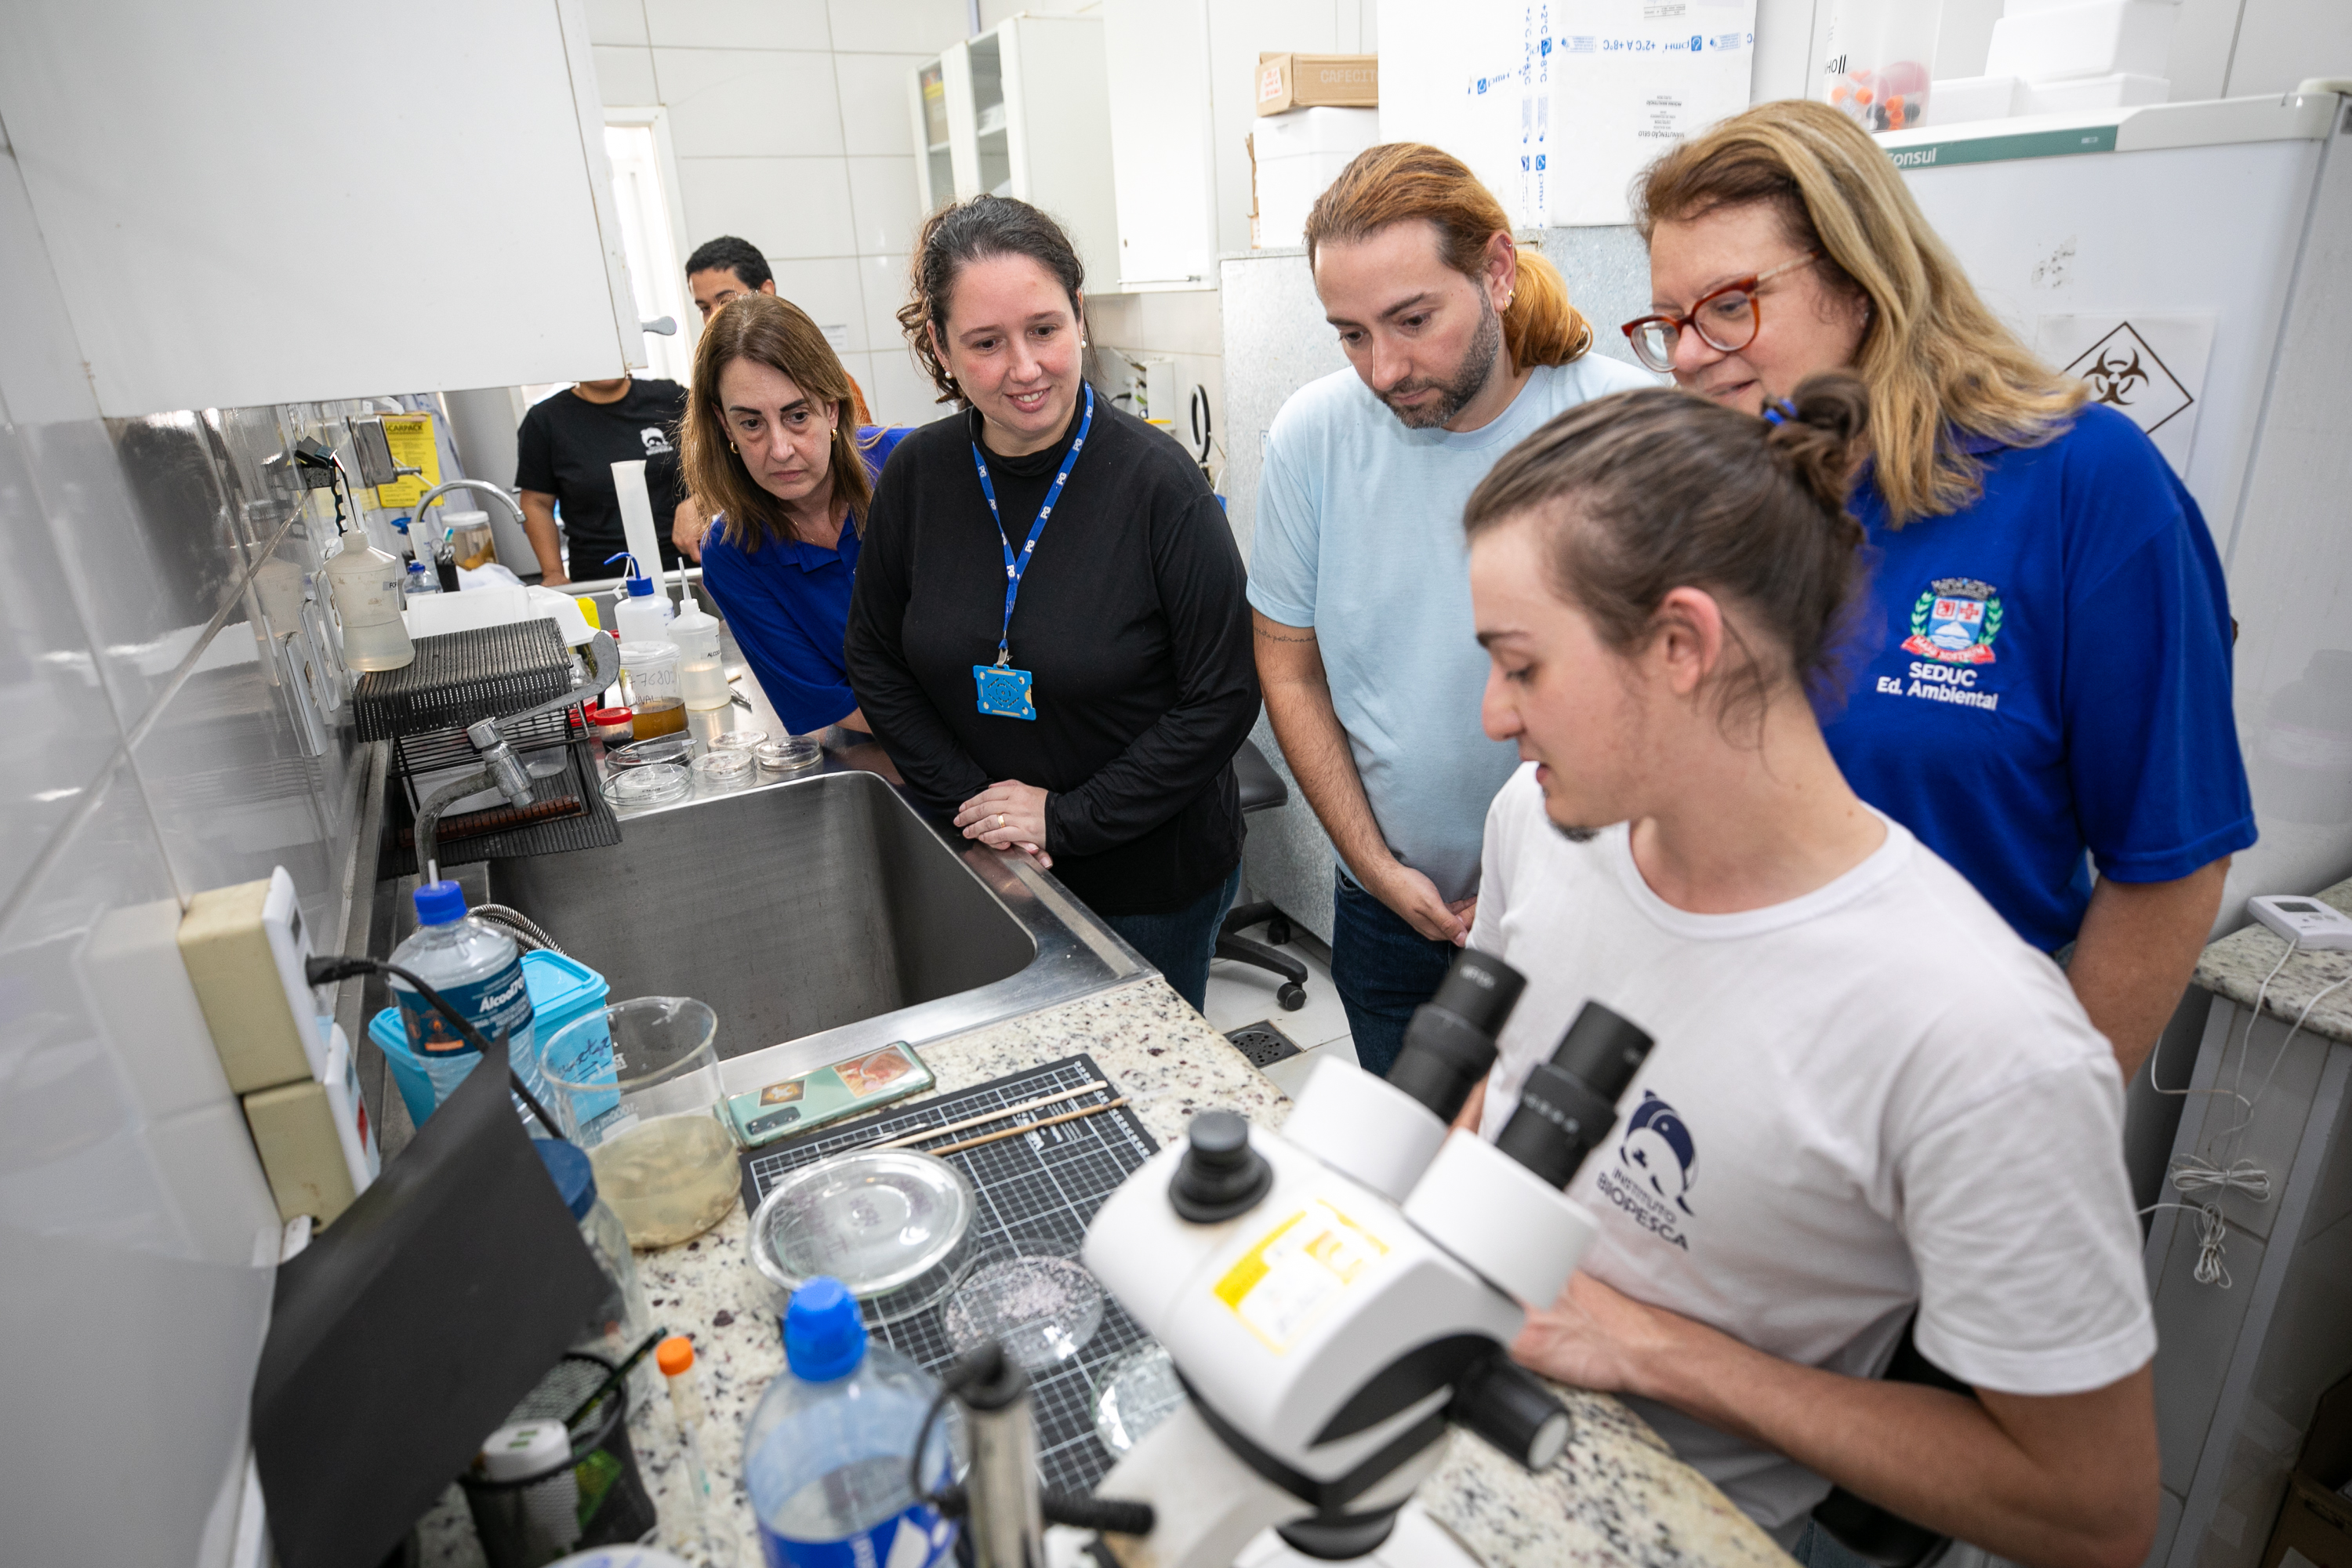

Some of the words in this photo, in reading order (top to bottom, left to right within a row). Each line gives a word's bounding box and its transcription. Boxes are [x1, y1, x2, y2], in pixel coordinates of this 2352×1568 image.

[1320, 68, 1378, 84] CAFECIT
[1056, 472, 1068, 485] PG
[1040, 506, 1051, 519] PG
[1025, 539, 1036, 553] PG
[1908, 661, 1978, 688] SEDUC
[1876, 676, 1903, 695] Ed.
[1907, 679, 1999, 711] Ambiental
[1596, 1169, 1690, 1252] BIOPESCA
